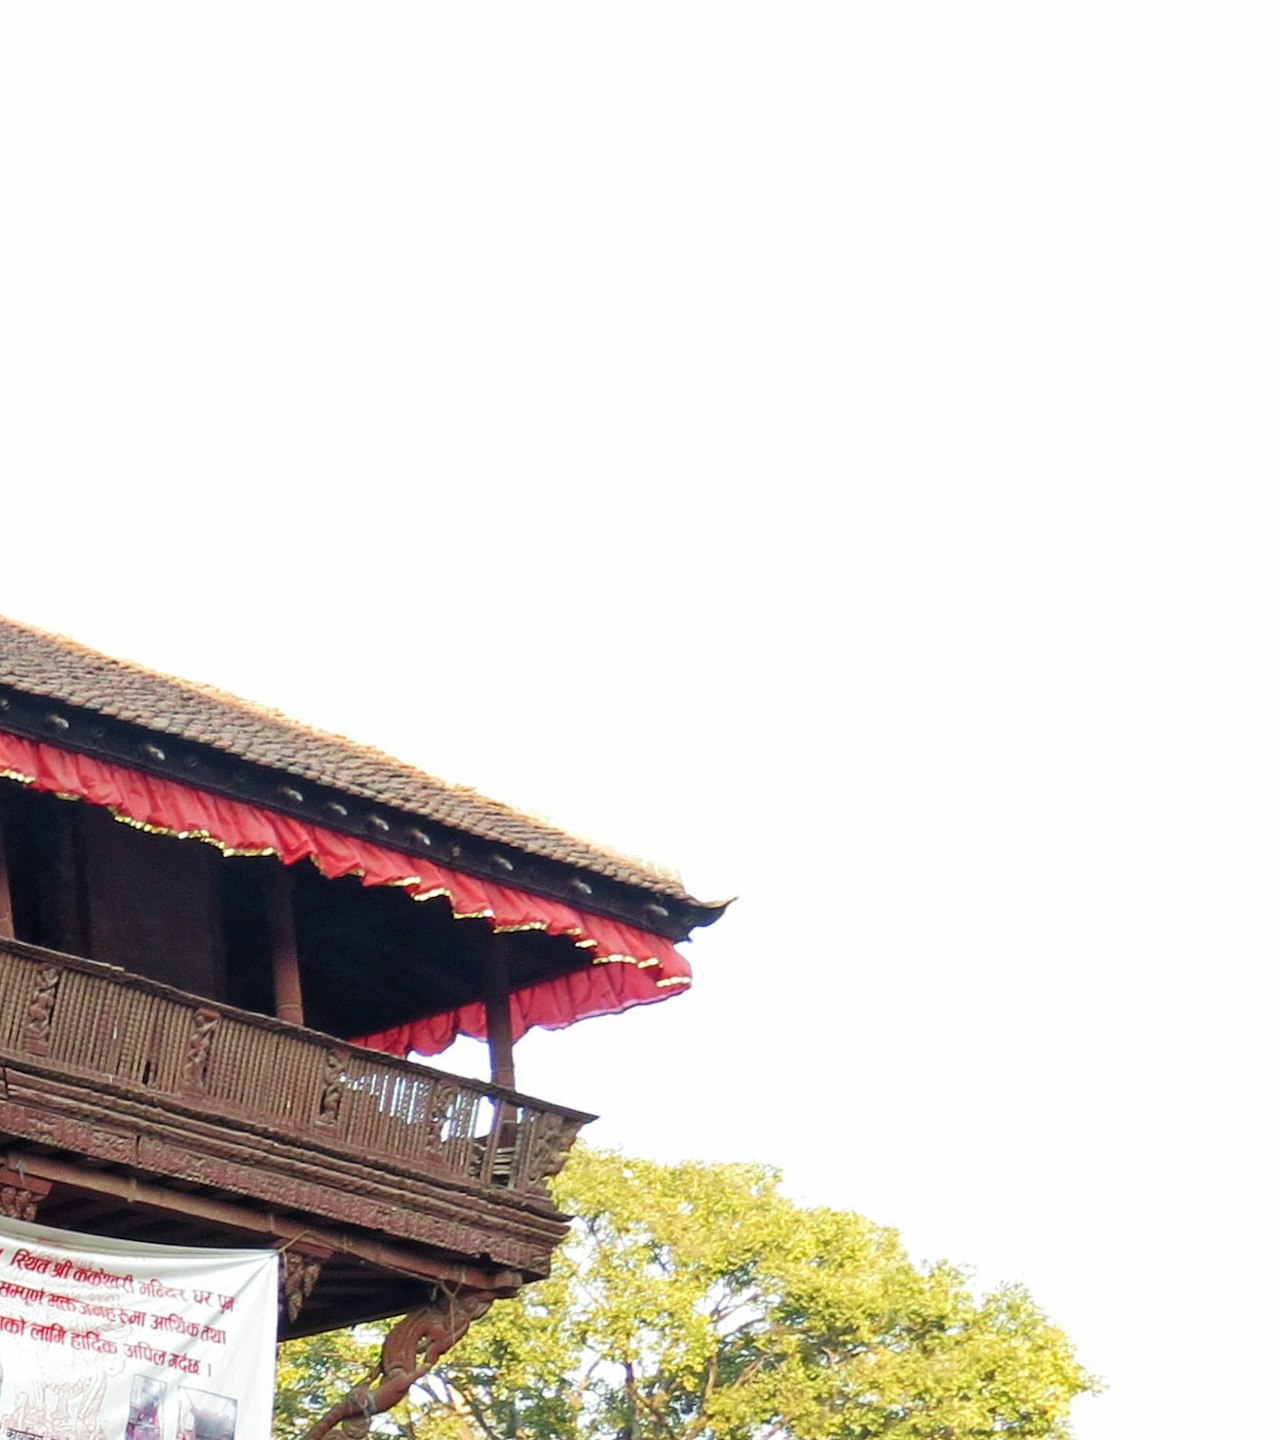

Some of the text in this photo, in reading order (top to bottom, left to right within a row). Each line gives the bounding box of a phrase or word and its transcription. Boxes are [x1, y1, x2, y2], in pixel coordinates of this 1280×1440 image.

[10, 1248, 53, 1274] स्थित
[51, 1258, 73, 1279] श्री
[192, 1290, 213, 1307] घर
[30, 1320, 68, 1345] लागि
[70, 1330, 118, 1355] हार्दिक
[123, 1341, 167, 1366] अपिल
[200, 1325, 227, 1345] तथा
